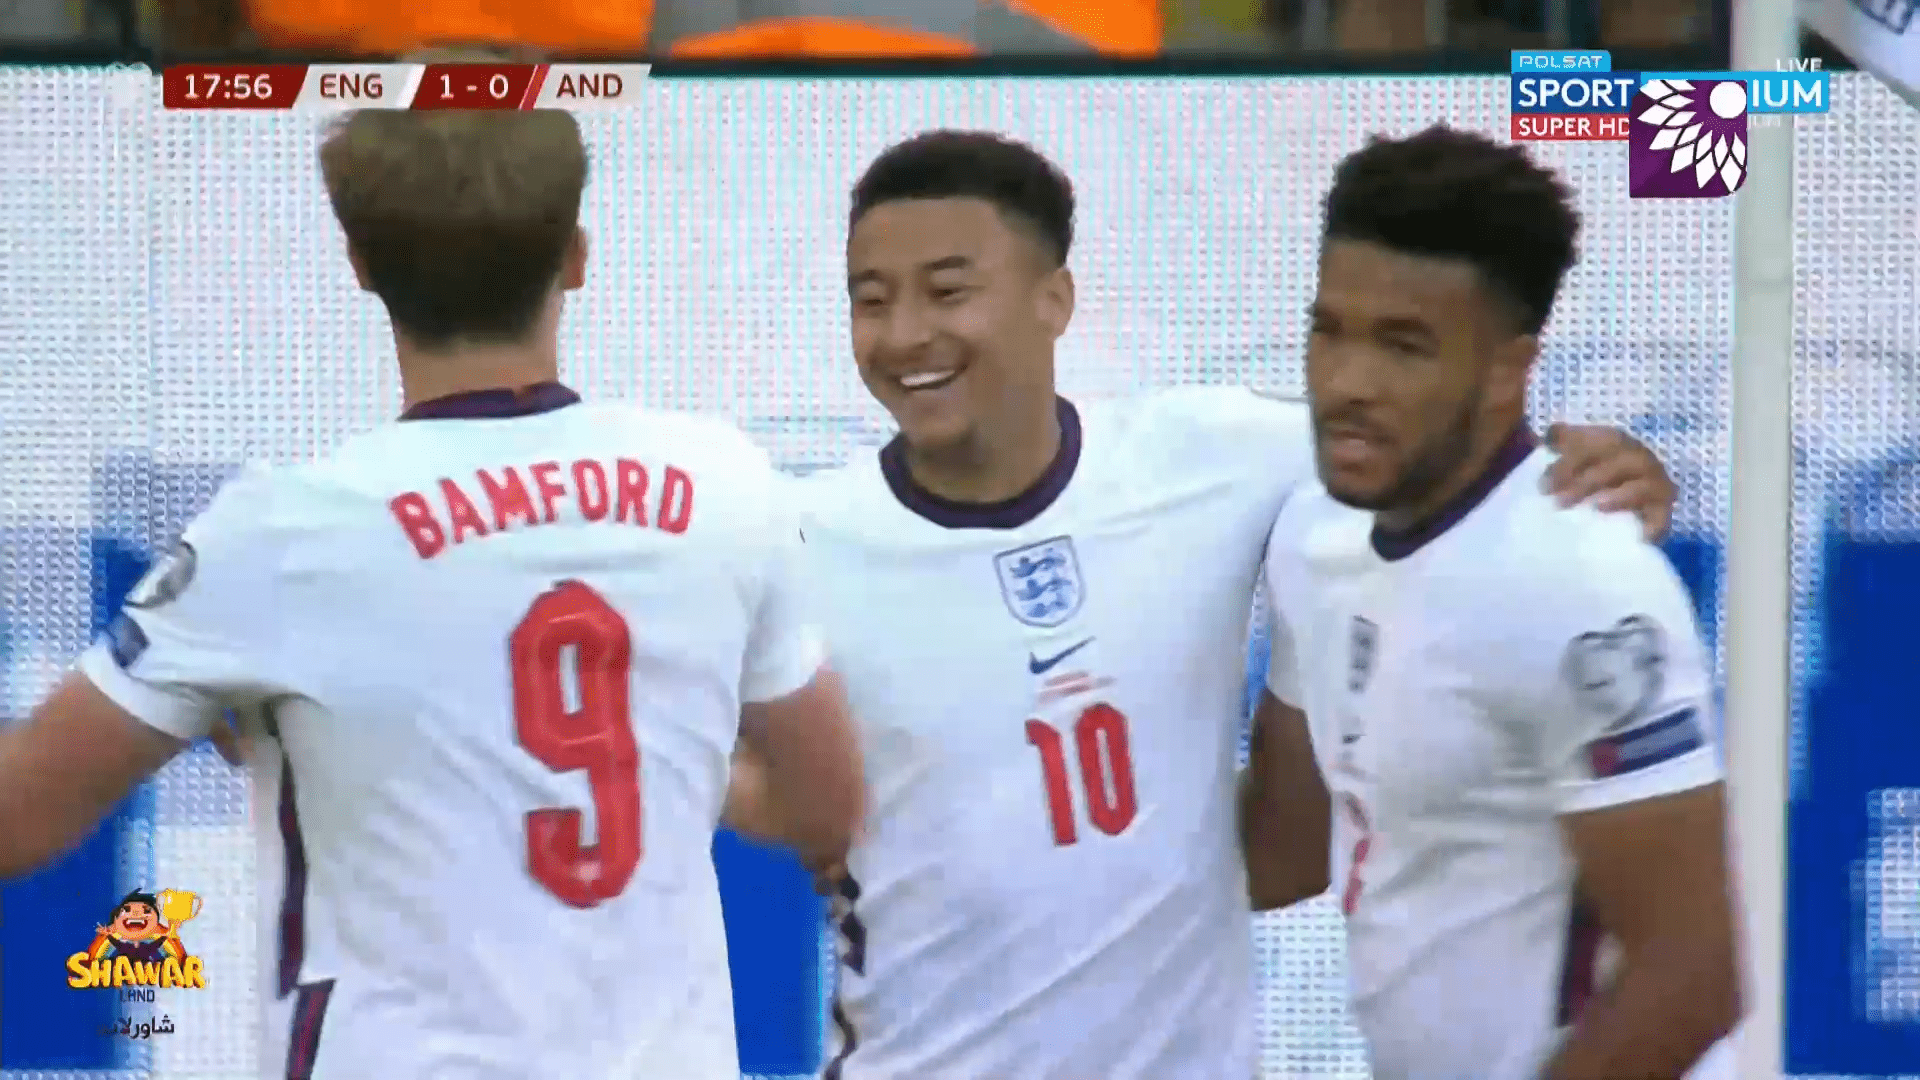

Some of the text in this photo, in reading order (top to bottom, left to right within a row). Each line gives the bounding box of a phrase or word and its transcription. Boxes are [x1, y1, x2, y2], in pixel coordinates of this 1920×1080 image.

[387, 457, 695, 560] BAMFORD
[508, 578, 642, 909] 9
[1024, 702, 1139, 848] 10
